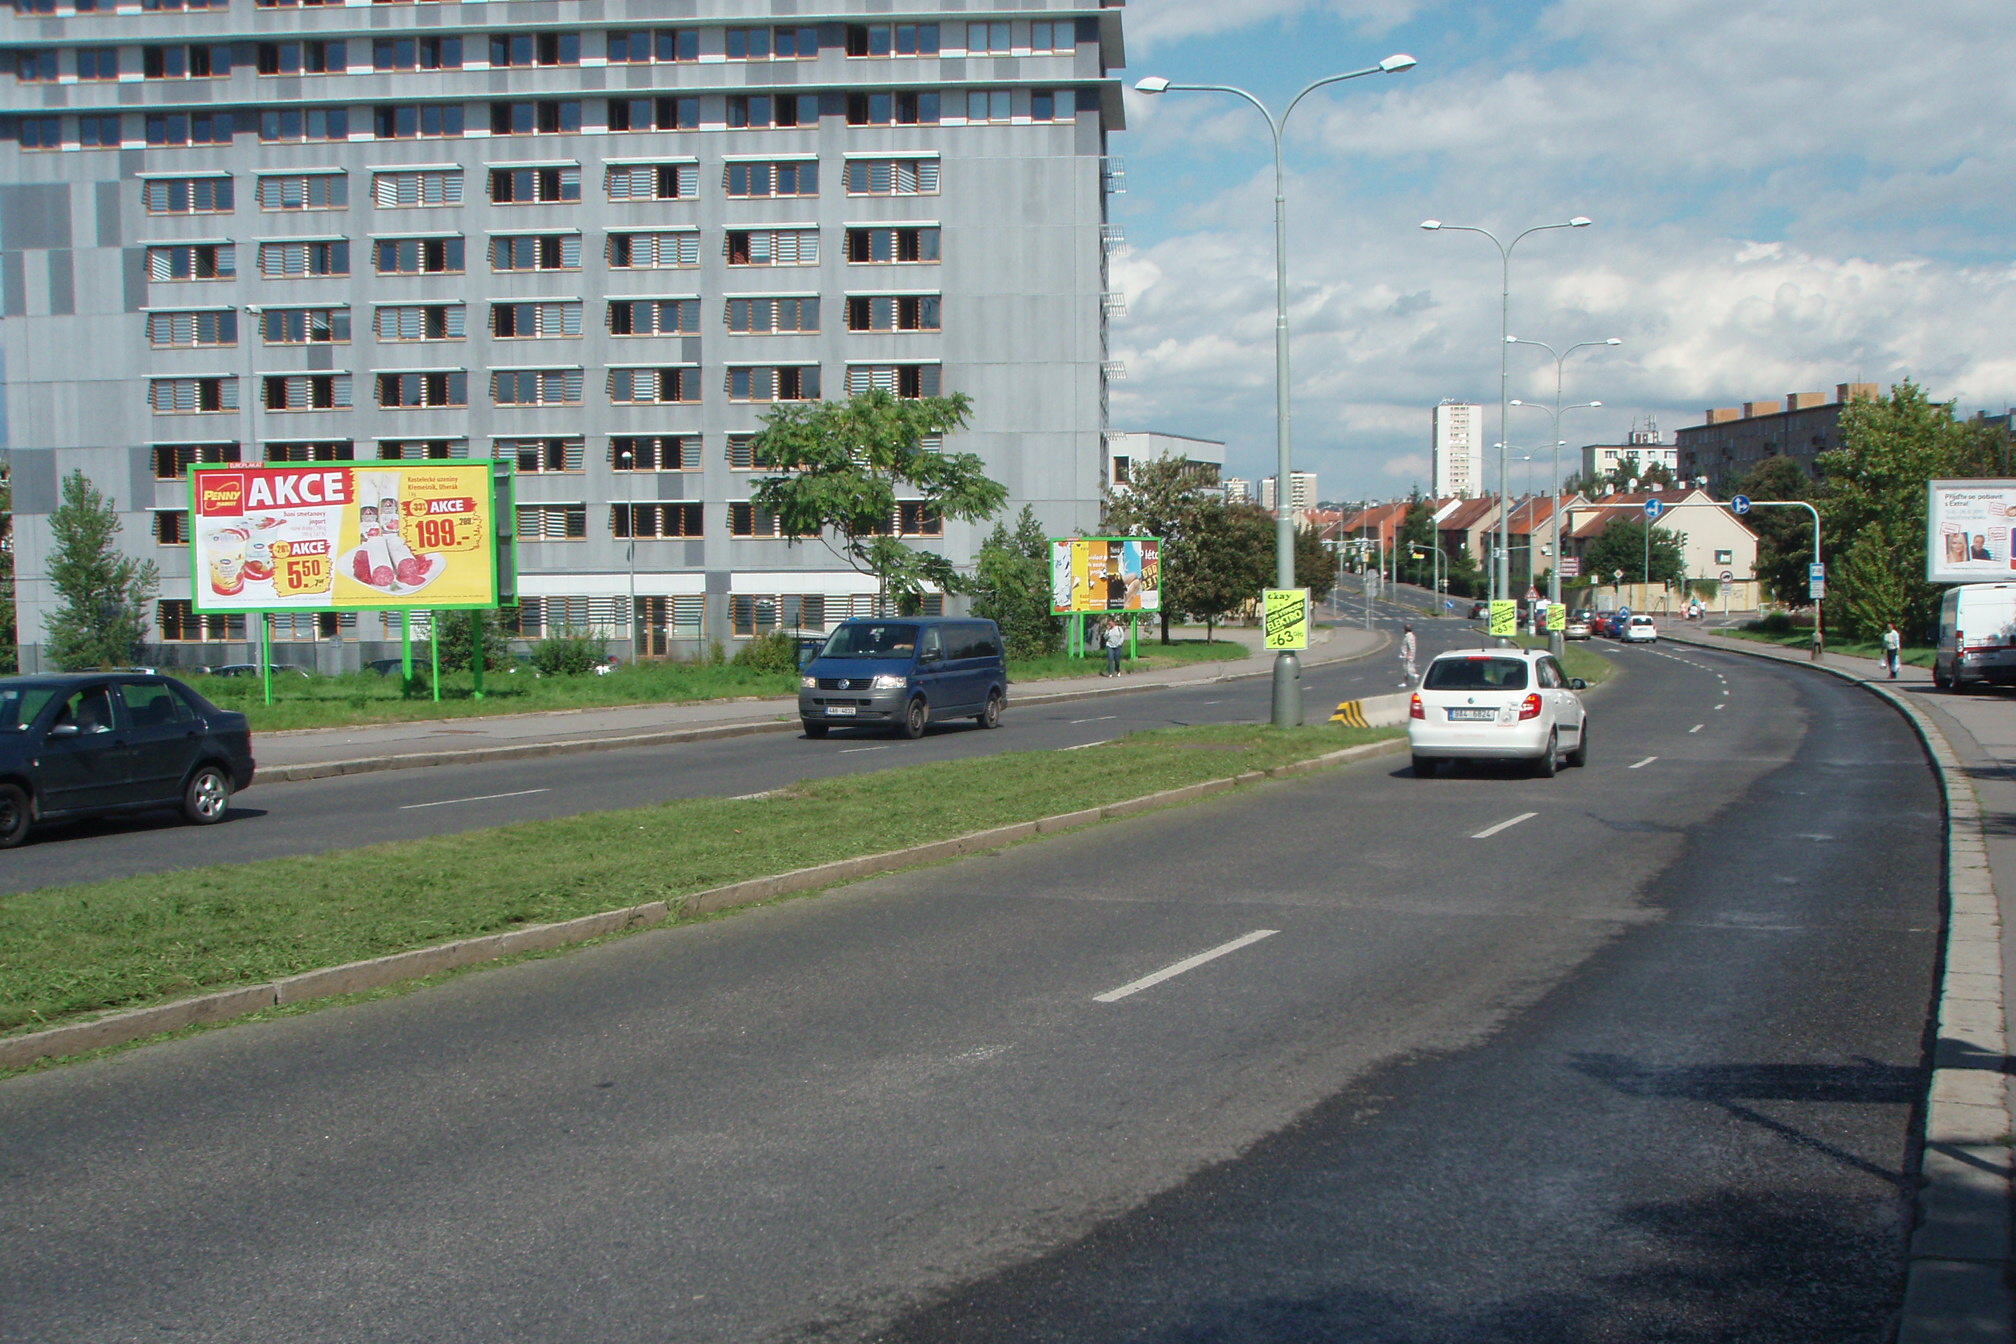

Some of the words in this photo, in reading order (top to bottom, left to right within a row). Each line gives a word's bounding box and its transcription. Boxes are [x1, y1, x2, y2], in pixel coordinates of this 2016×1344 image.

[203, 489, 241, 501] PENNY
[248, 471, 345, 507] AKCE
[429, 499, 464, 513] AKCE
[291, 541, 326, 555] AKCE
[1266, 609, 1302, 632] ELEKTRO
